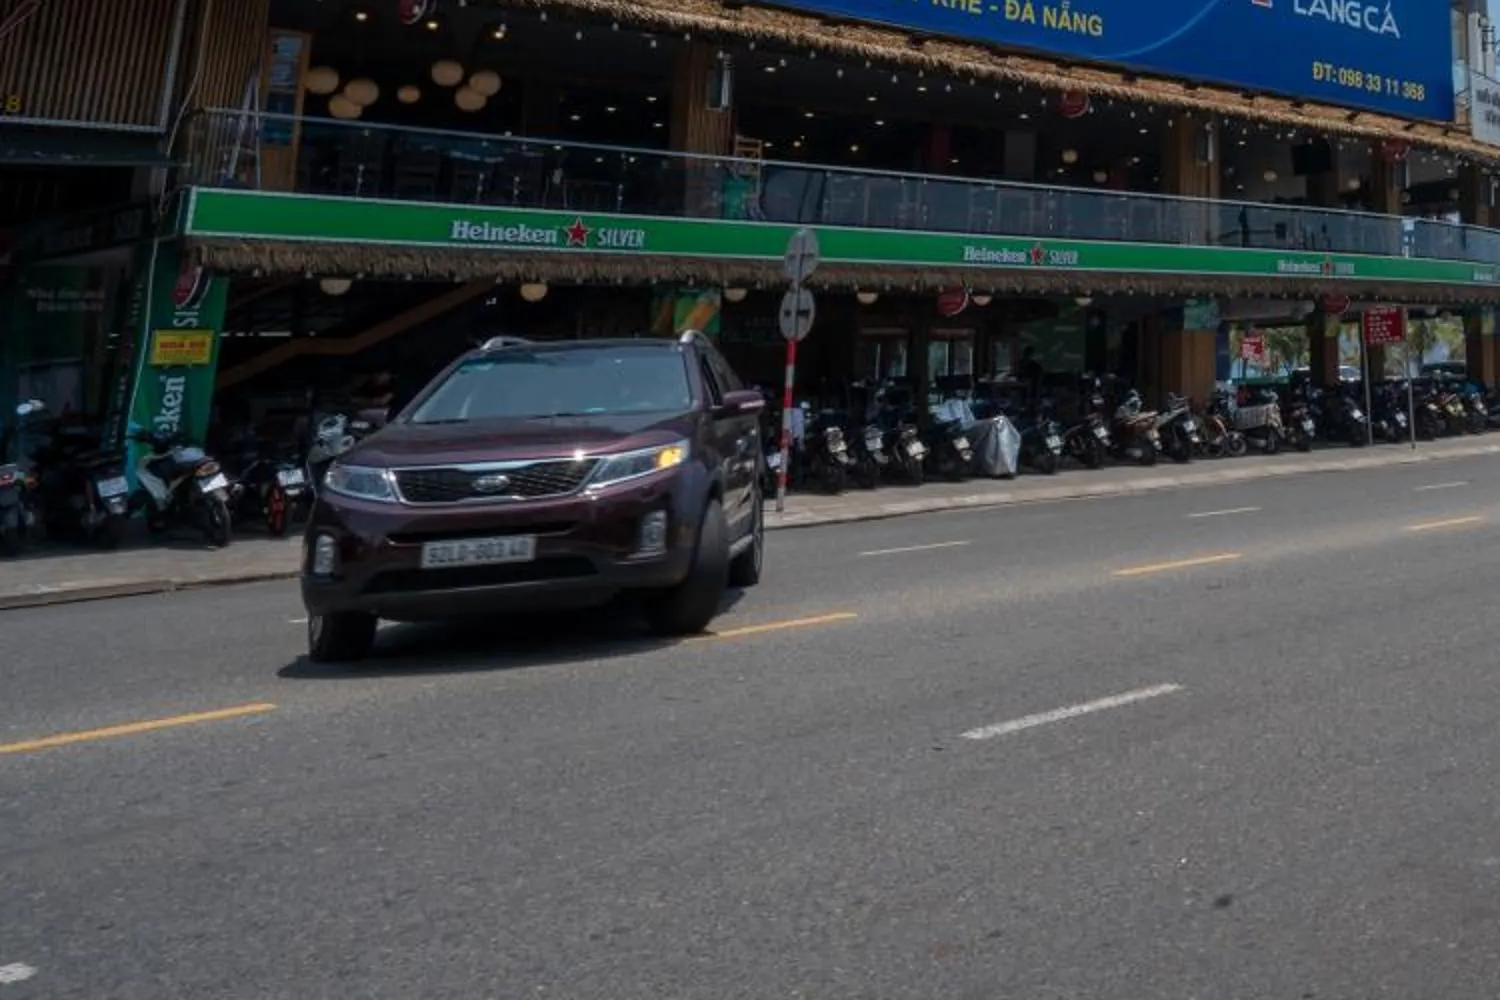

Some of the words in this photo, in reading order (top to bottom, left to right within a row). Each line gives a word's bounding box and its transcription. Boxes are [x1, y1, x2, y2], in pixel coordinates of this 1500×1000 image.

[1043, 0, 1103, 37] NẴNG
[1365, 73, 1381, 92] 33
[1385, 78, 1399, 96] 11
[451, 219, 557, 245] Heineken
[597, 228, 645, 247] SILVER
